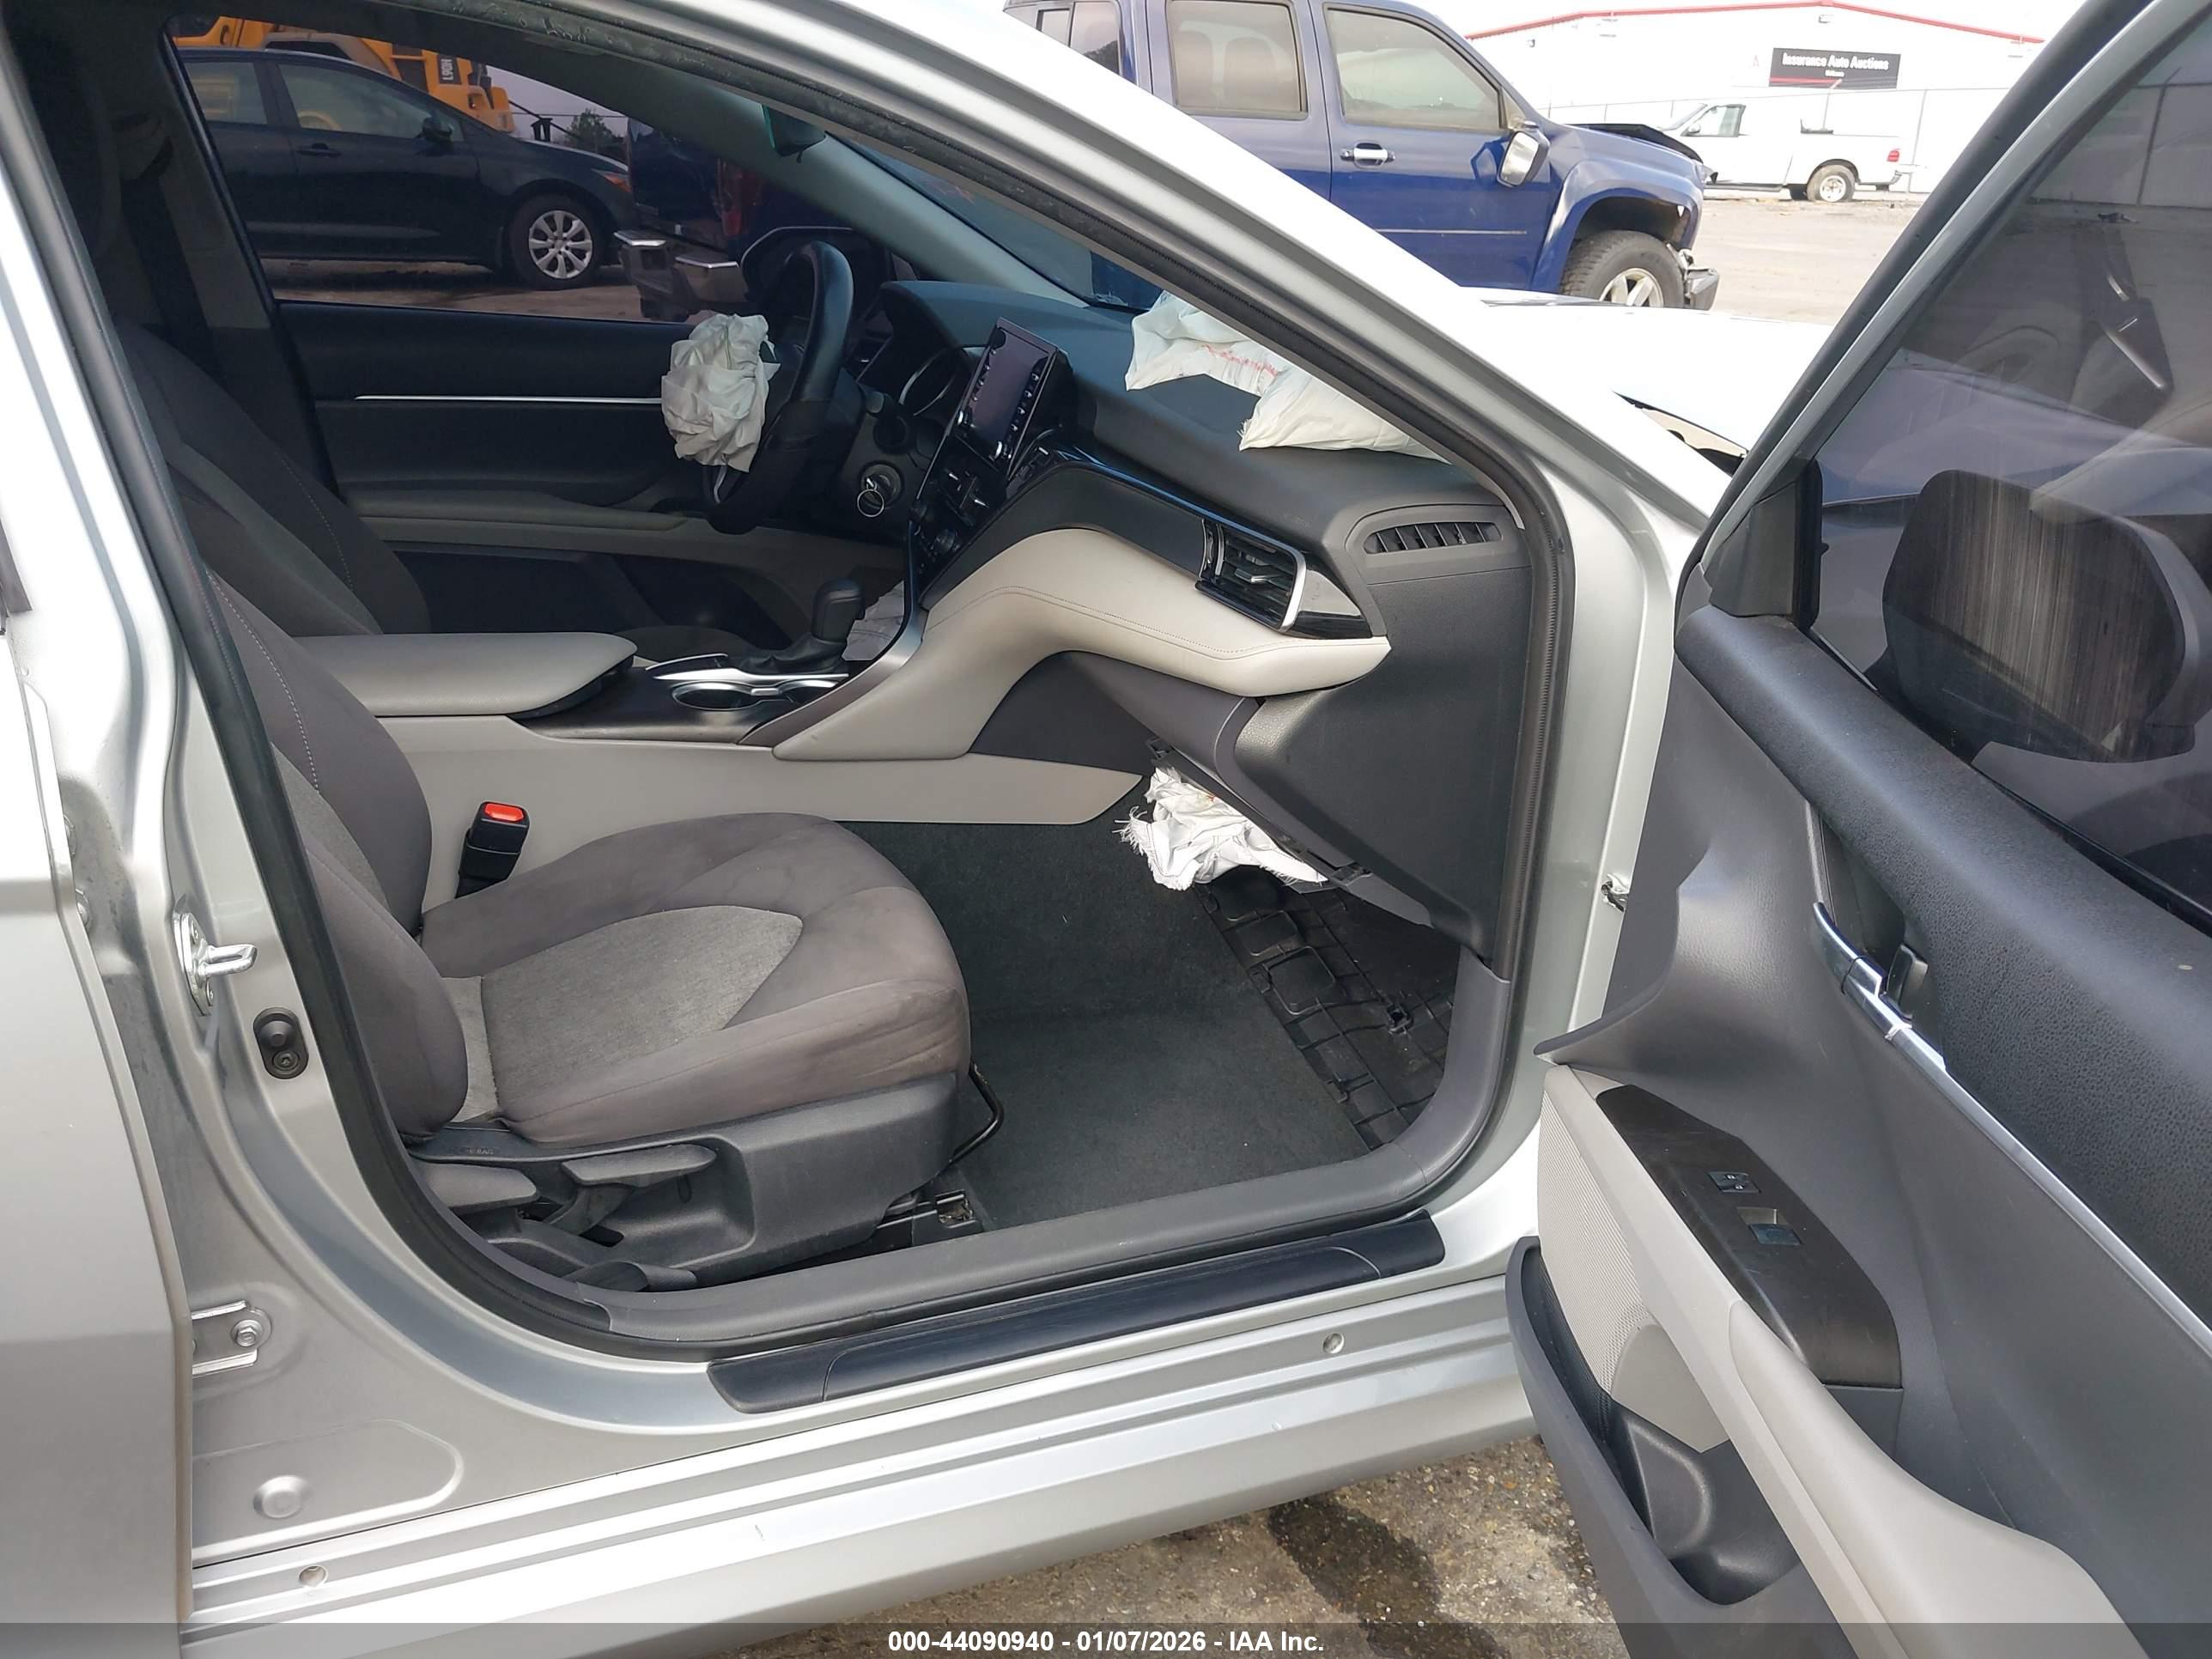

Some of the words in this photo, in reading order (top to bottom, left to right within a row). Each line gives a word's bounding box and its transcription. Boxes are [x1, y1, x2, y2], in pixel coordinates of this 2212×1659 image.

[1783, 52, 1827, 67] Insurance
[1827, 55, 1850, 68] Auto
[1850, 56, 1889, 70] Auctions
